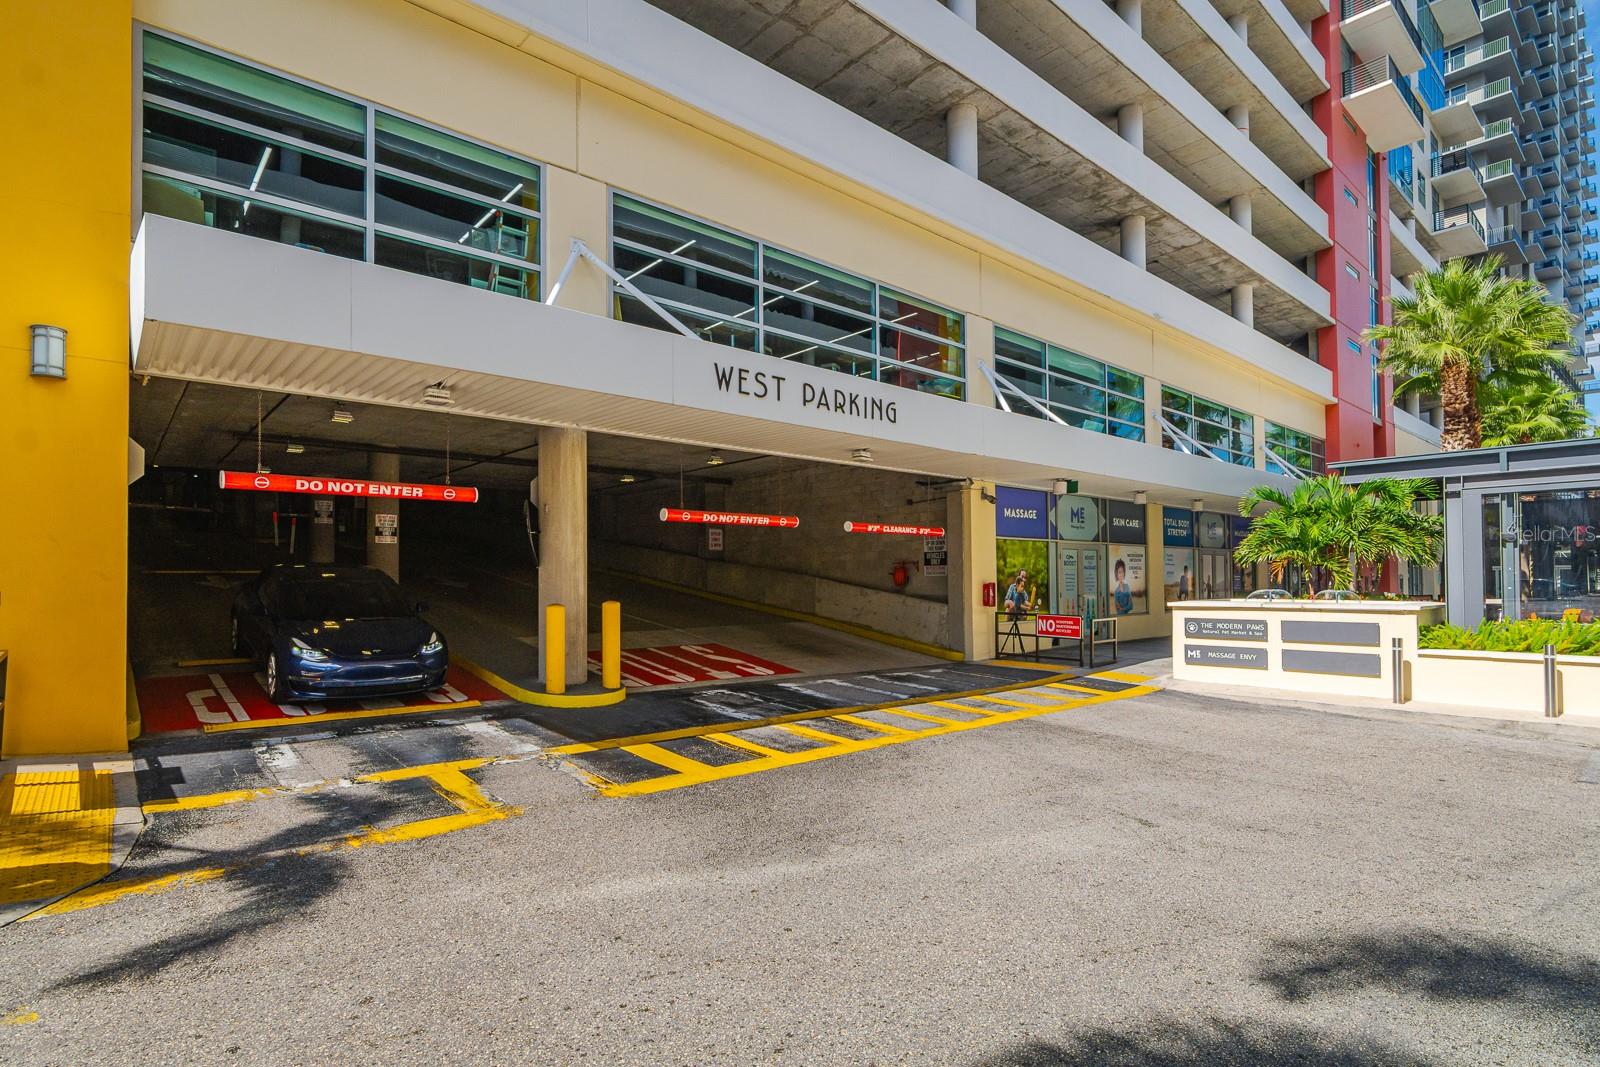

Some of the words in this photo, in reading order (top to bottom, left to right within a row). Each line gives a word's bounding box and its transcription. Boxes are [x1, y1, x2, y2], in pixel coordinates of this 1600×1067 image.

[714, 362, 786, 401] WEST
[802, 382, 897, 423] PARKING
[295, 479, 323, 491] DO
[327, 481, 365, 494] NOT
[368, 484, 424, 497] ENTER
[703, 513, 718, 522] DO
[719, 514, 739, 523] NOT
[740, 516, 770, 525] ENTER
[1004, 508, 1037, 519] MASSAGE
[1070, 506, 1085, 524] ME
[1113, 518, 1125, 526] SKIN
[1126, 519, 1139, 528] CARE
[1164, 518, 1178, 527] TOTAL
[883, 525, 917, 534] CLEARANCE
[1168, 528, 1187, 537] STRETCH
[1038, 618, 1055, 632] NO
[1207, 651, 1236, 659] MASSAGE
